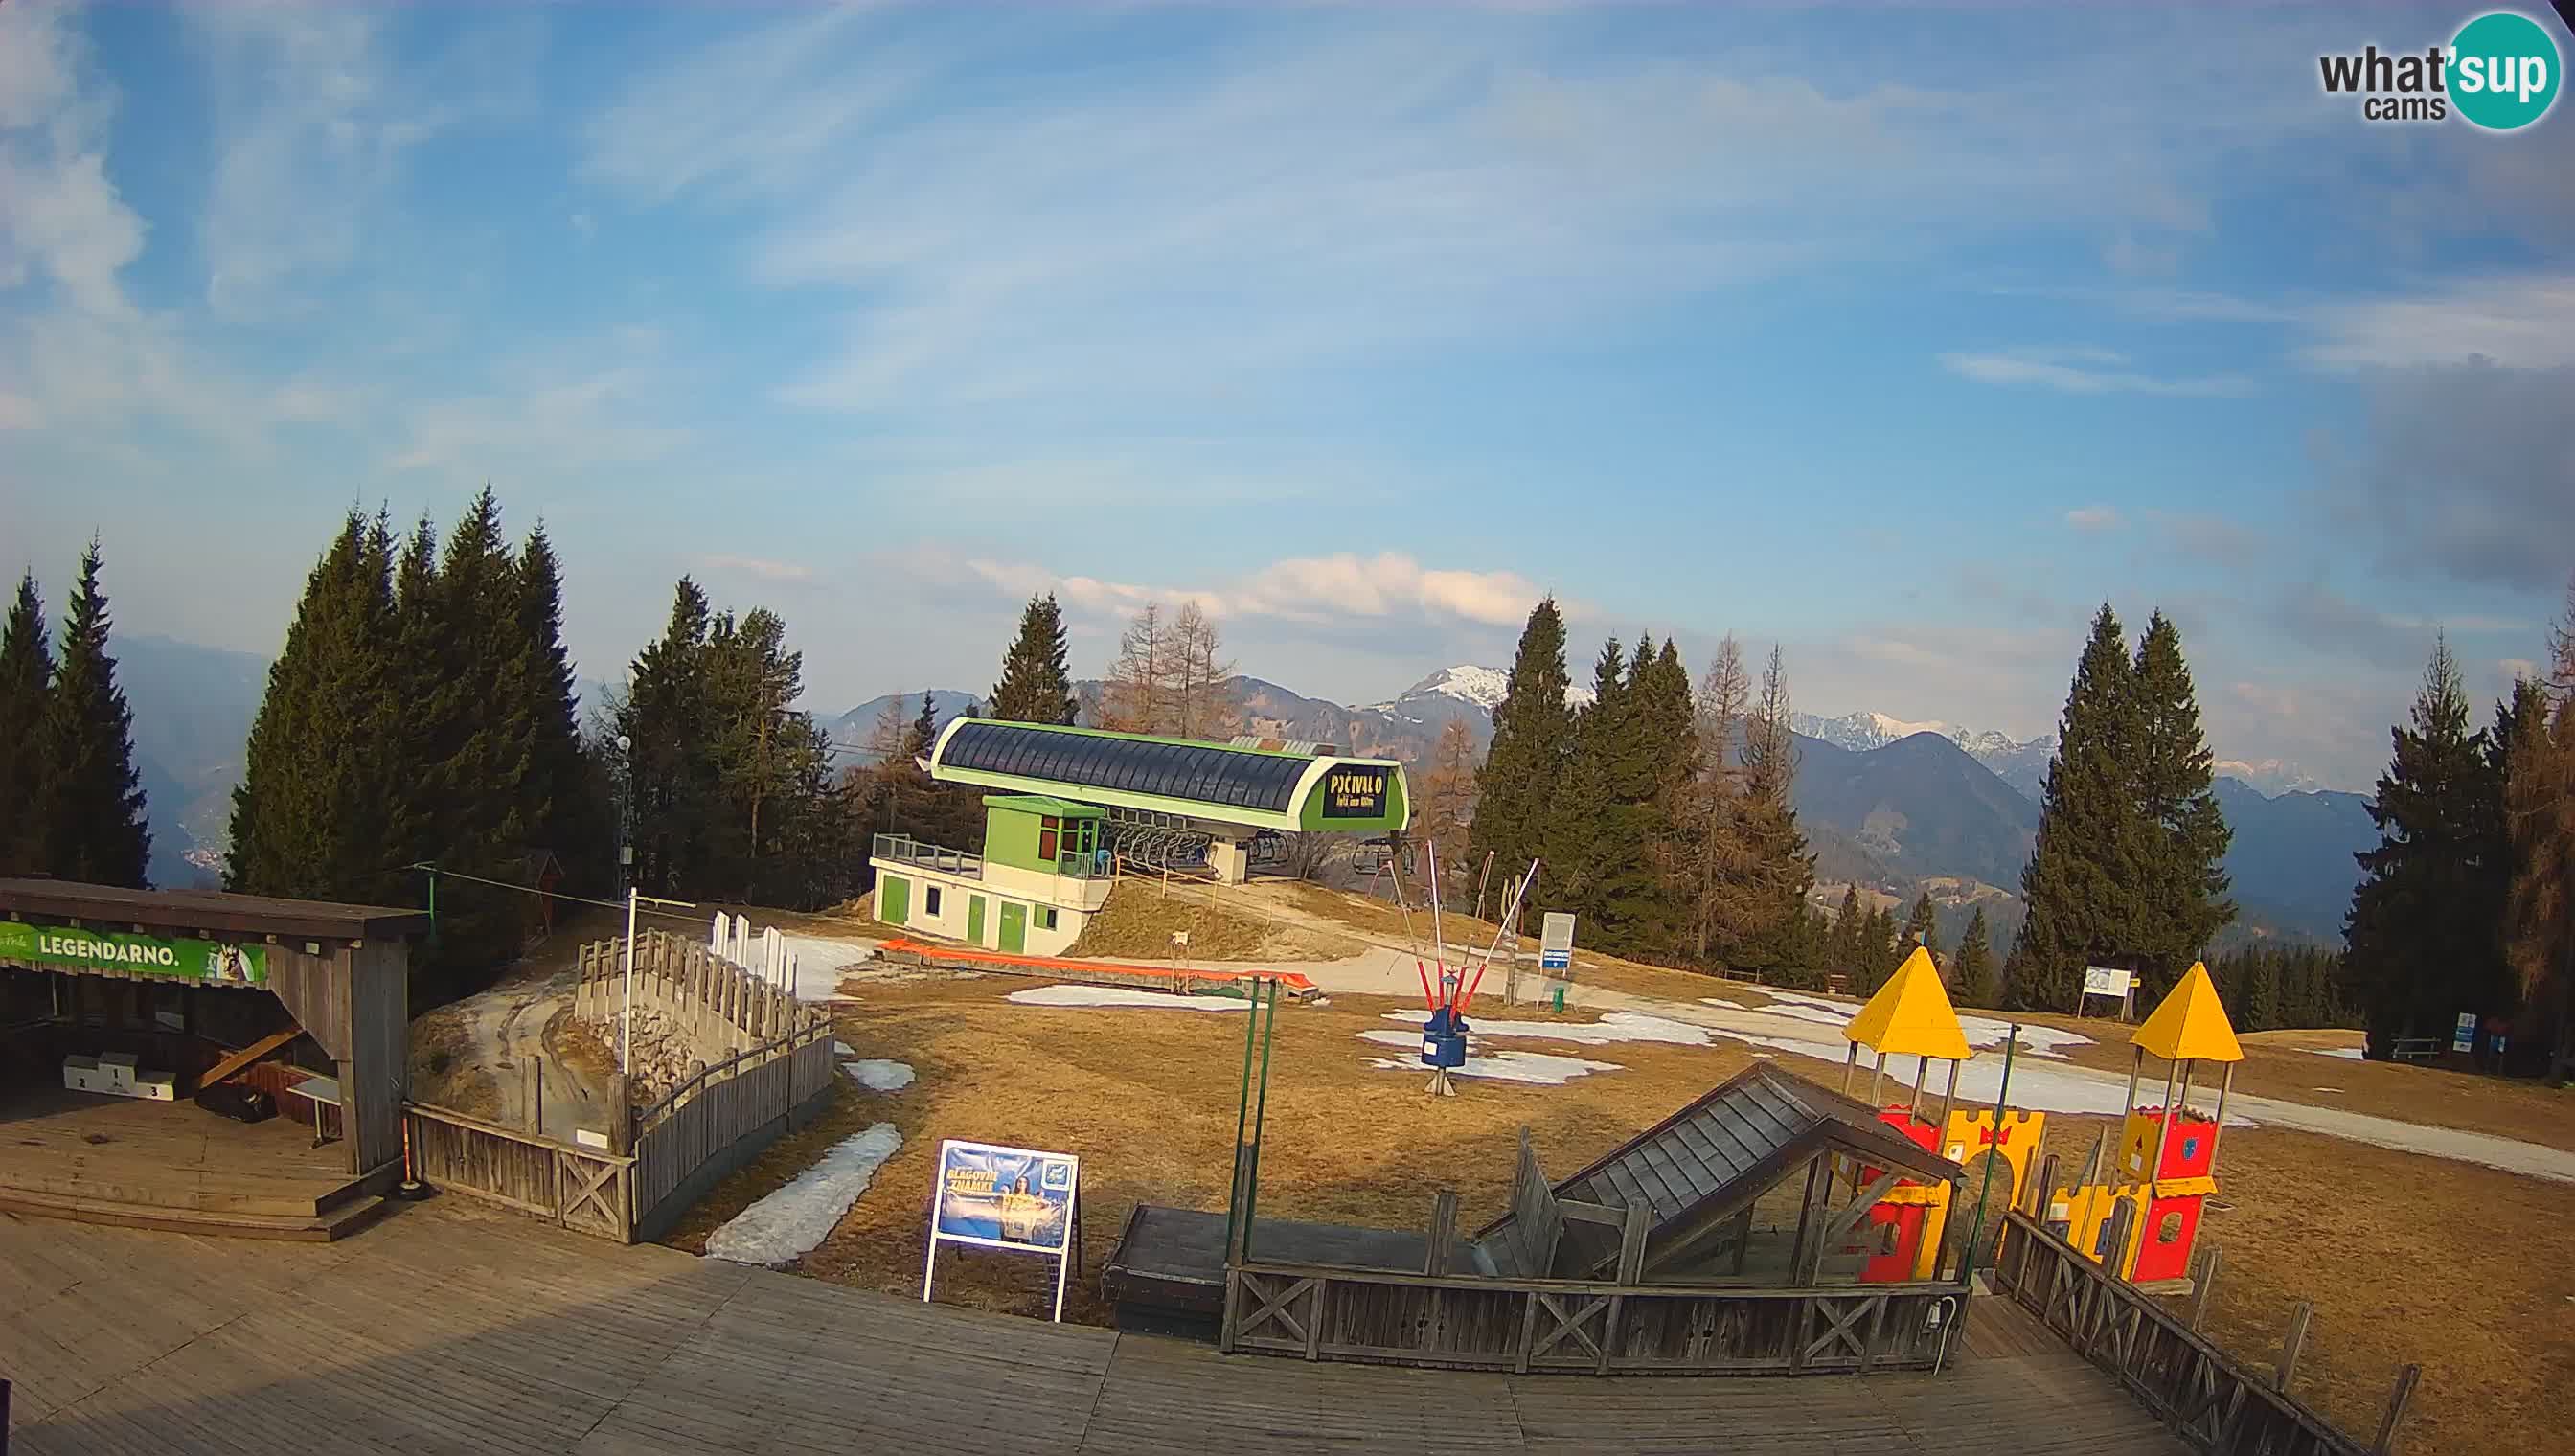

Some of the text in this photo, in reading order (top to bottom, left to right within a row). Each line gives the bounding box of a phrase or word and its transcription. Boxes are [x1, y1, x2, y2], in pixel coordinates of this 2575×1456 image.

[39, 934, 179, 967] LEGENDARNO.
[79, 1078, 85, 1088] 2
[150, 1086, 158, 1097] 3
